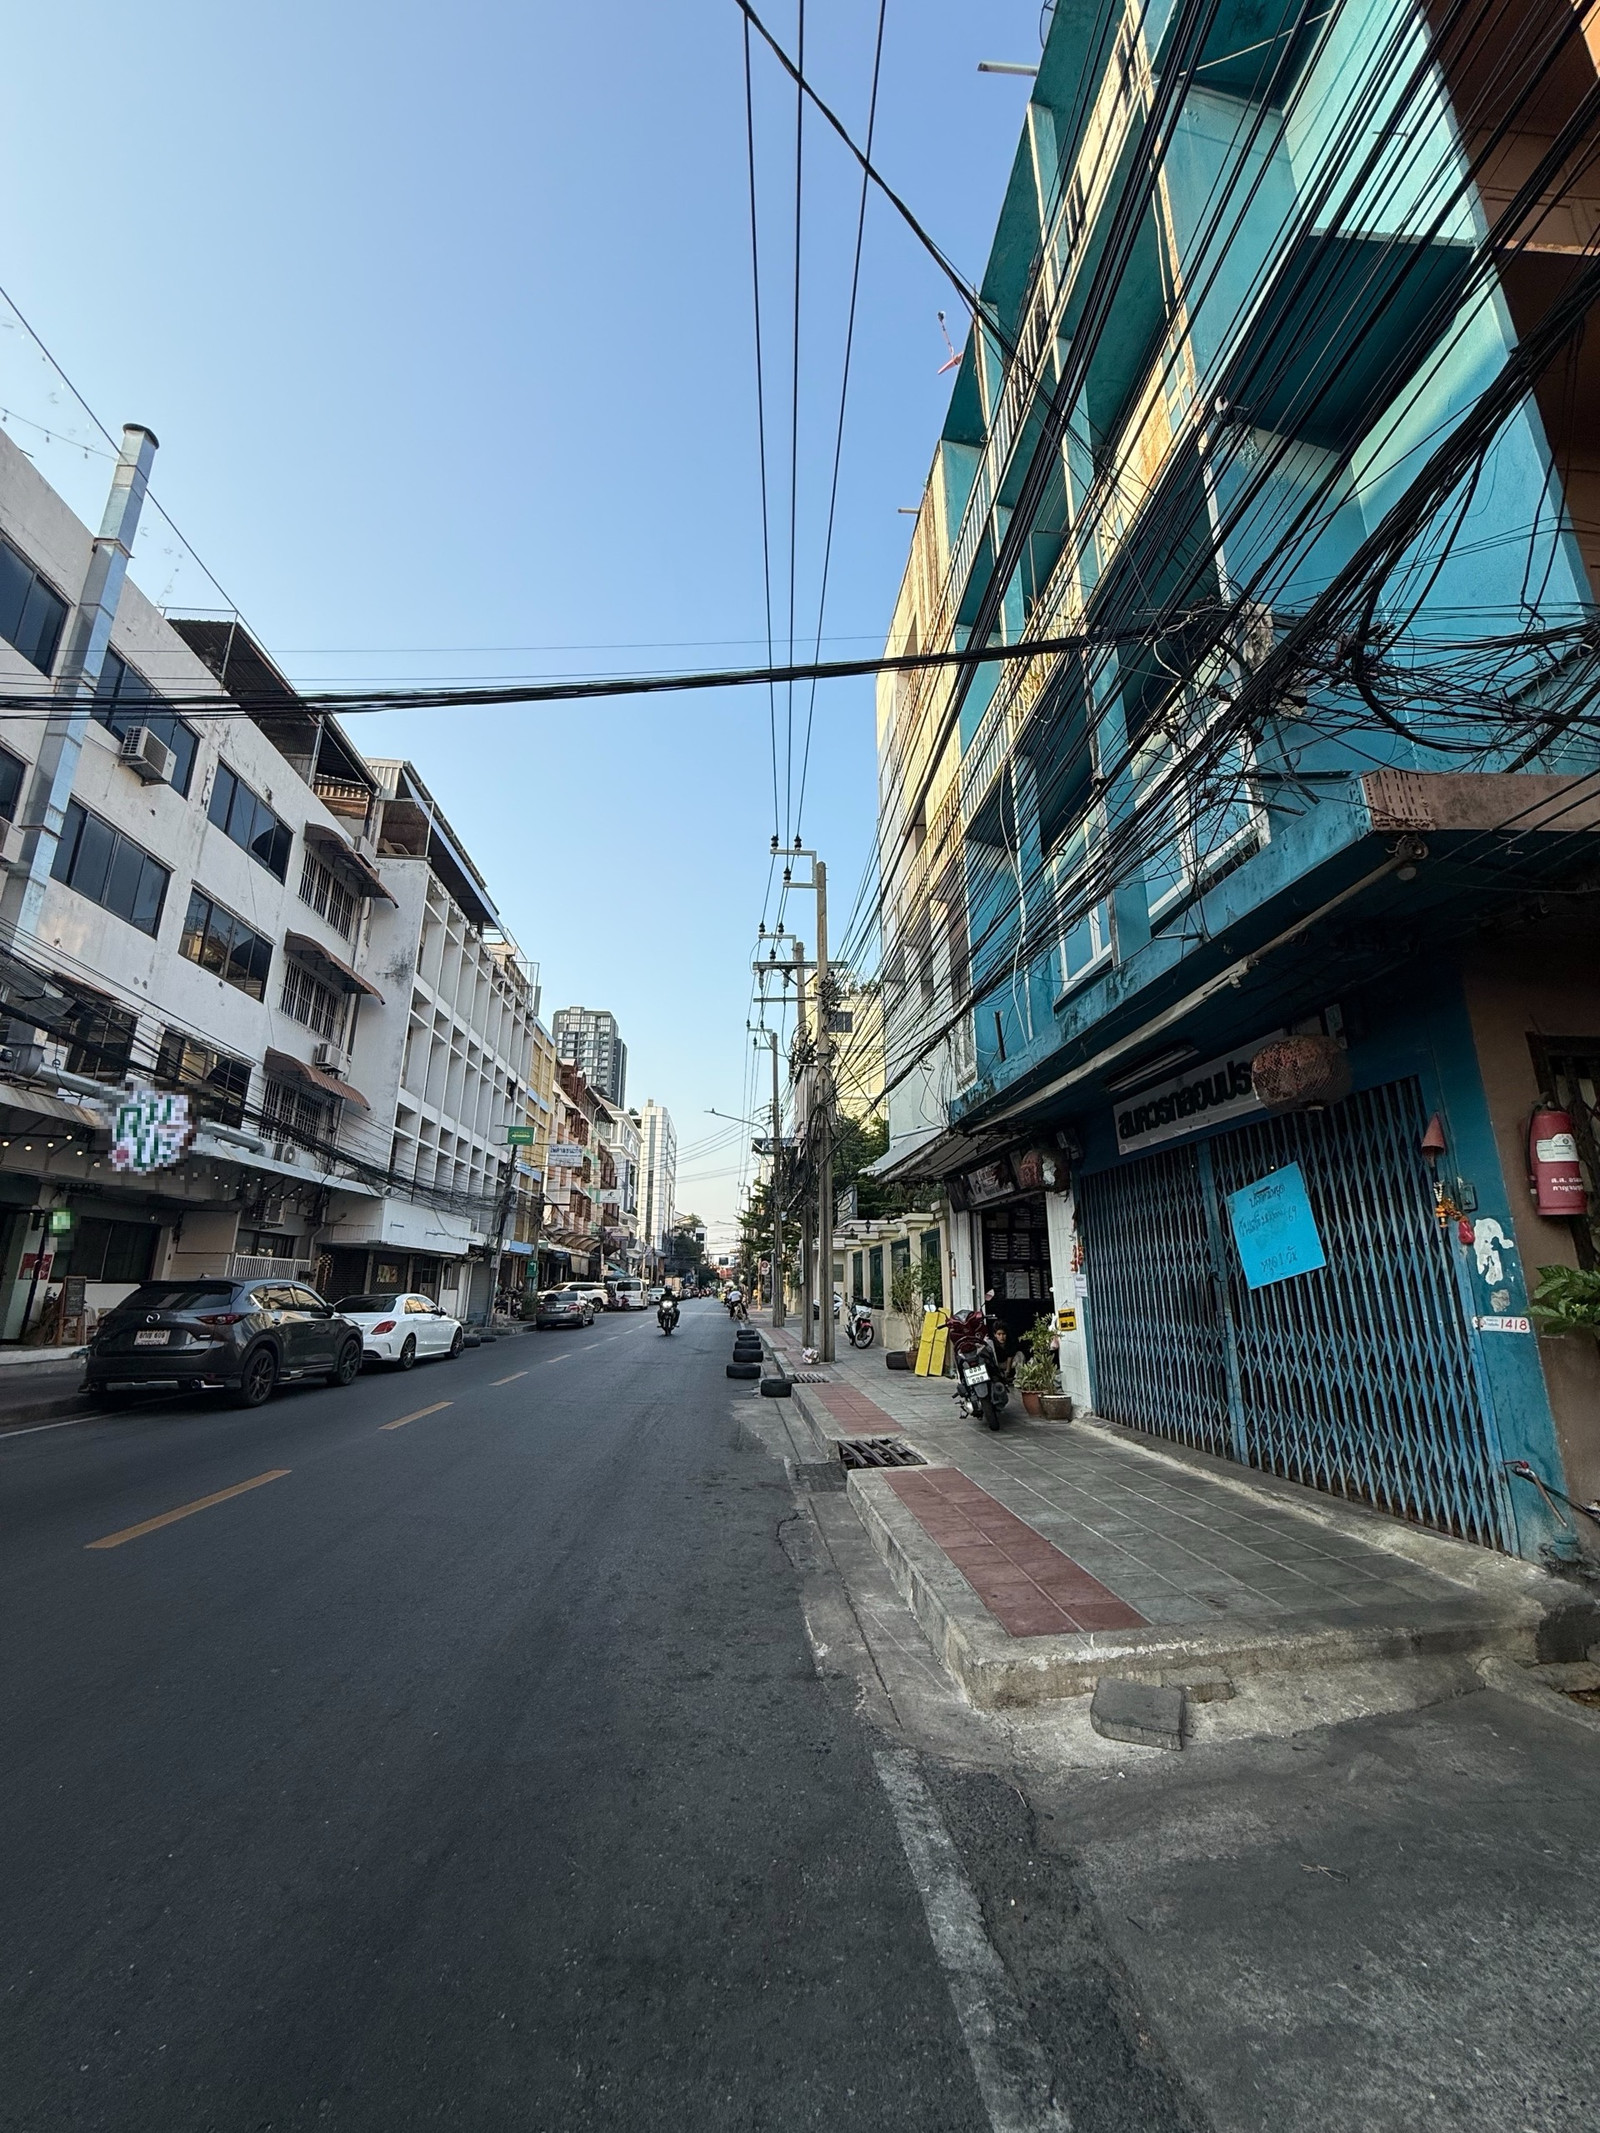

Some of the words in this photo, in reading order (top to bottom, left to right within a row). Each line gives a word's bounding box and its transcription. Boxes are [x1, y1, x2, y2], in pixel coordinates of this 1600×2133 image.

[1118, 1060, 1252, 1140] สมควรกลอนปร
[1501, 1318, 1528, 1331] 1418
